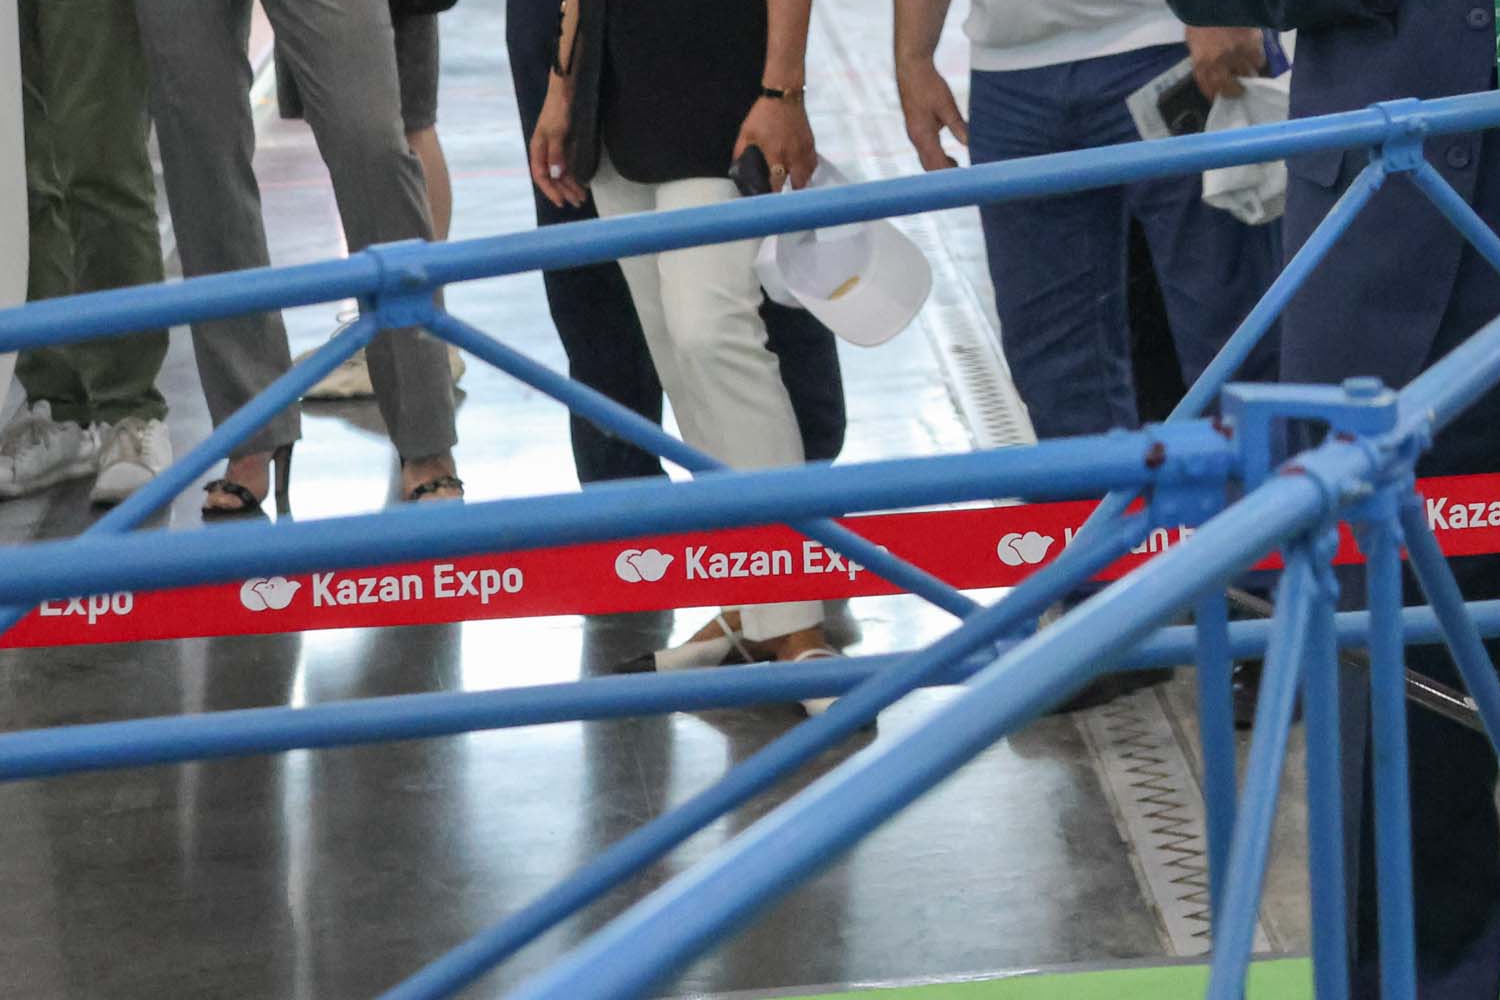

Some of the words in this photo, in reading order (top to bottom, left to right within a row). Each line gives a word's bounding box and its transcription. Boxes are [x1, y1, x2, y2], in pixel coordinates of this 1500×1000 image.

[685, 544, 792, 580] Kazan
[312, 571, 423, 607] Kazan
[434, 563, 524, 604] Expo
